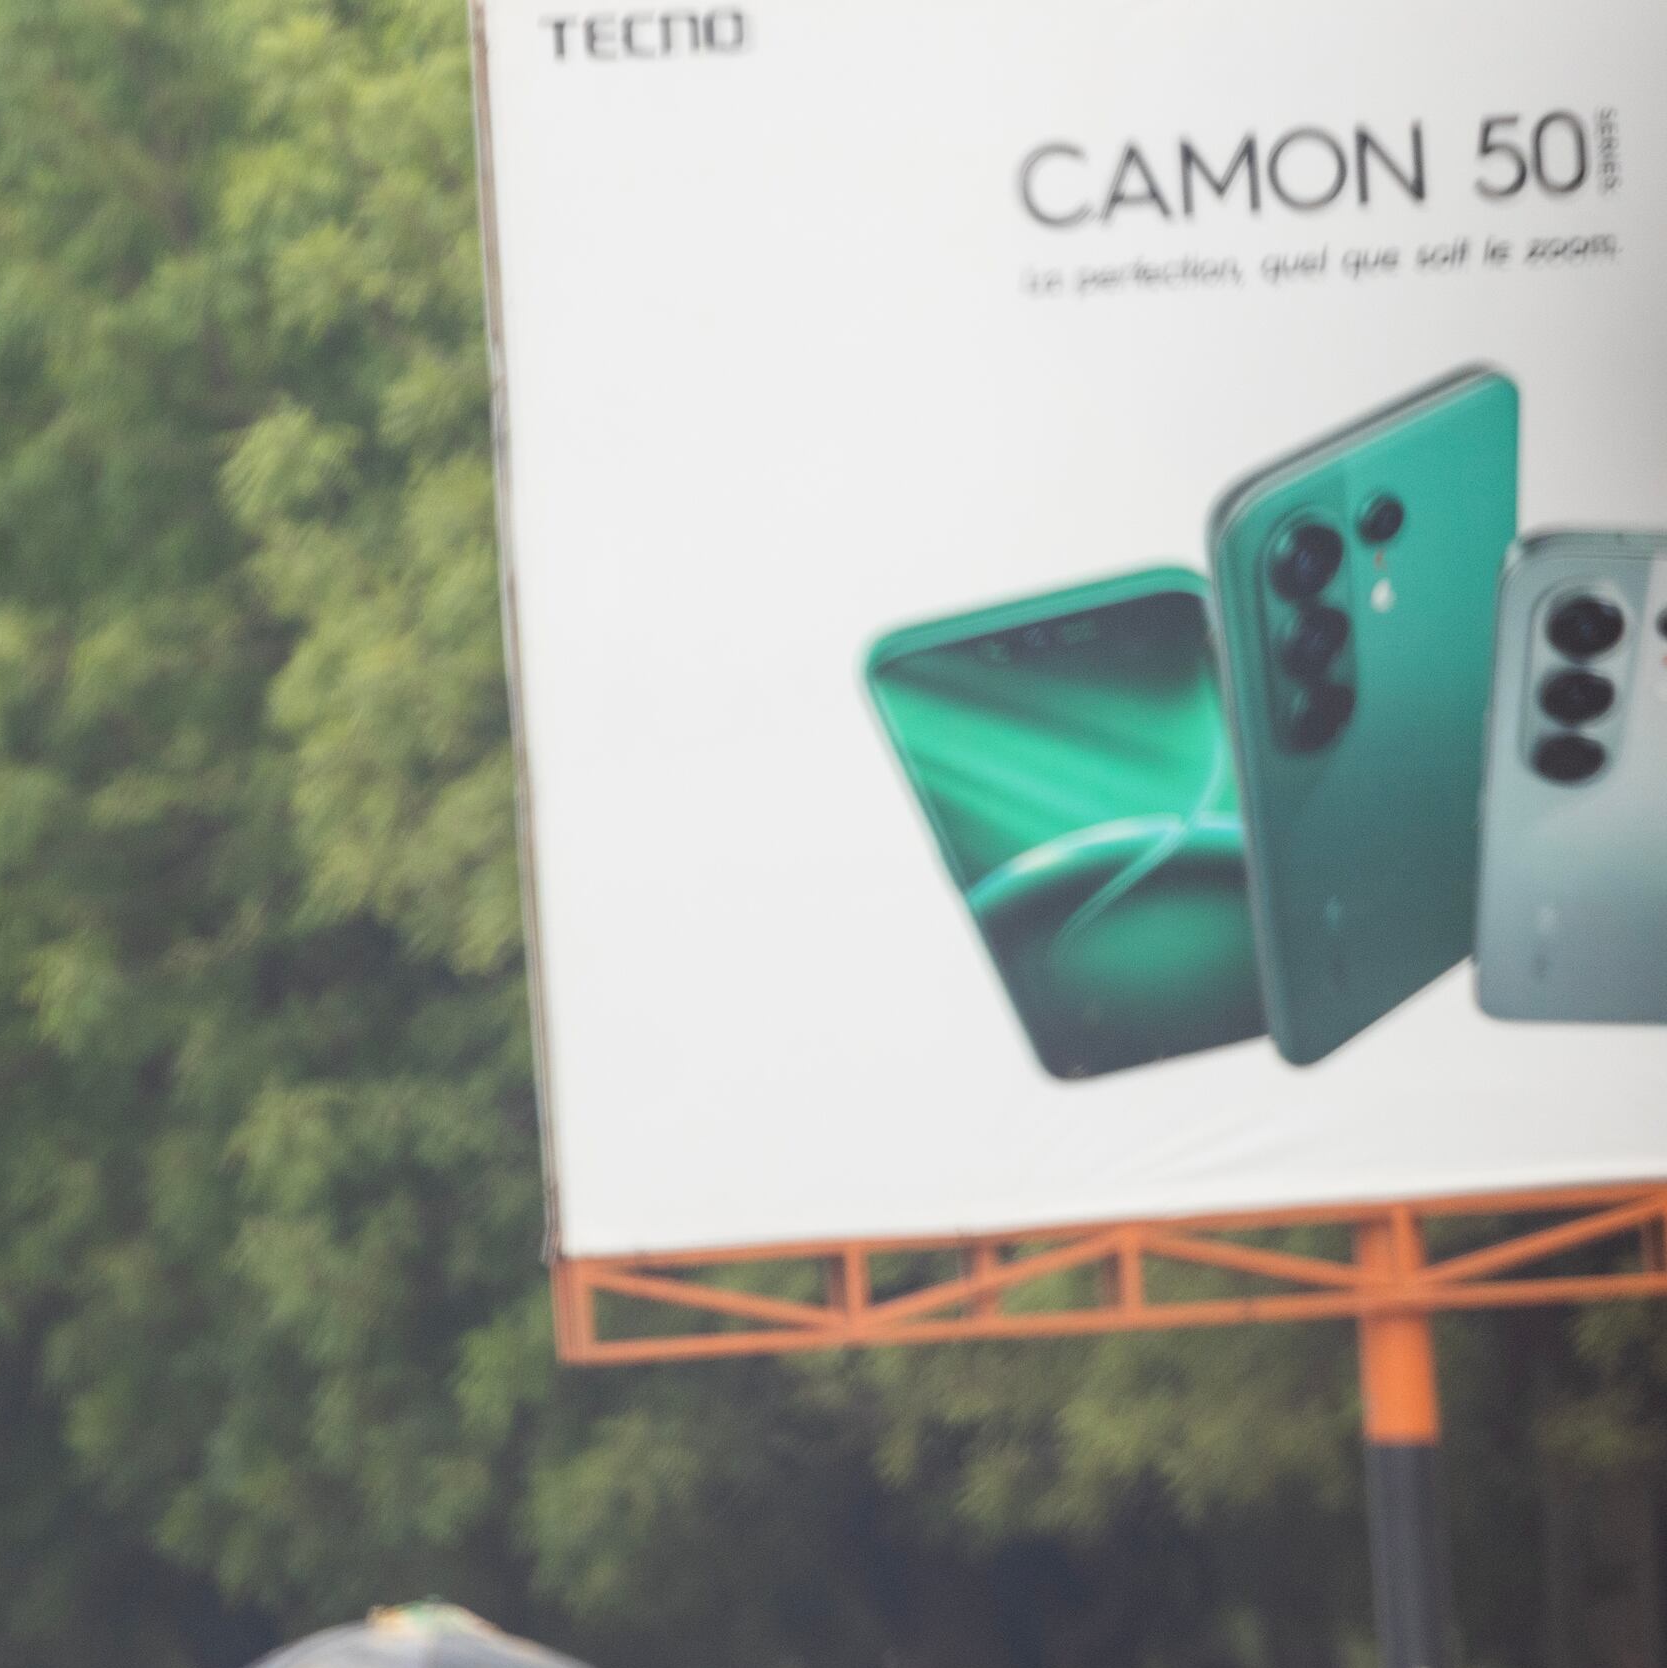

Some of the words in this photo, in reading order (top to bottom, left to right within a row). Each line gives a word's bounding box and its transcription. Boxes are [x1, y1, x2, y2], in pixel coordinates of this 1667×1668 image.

[538, 8, 746, 62] TECNO
[1018, 119, 1427, 229] CAMON
[1473, 108, 1589, 202] 50
[1259, 240, 1329, 286] quel
[1341, 247, 1401, 281] que
